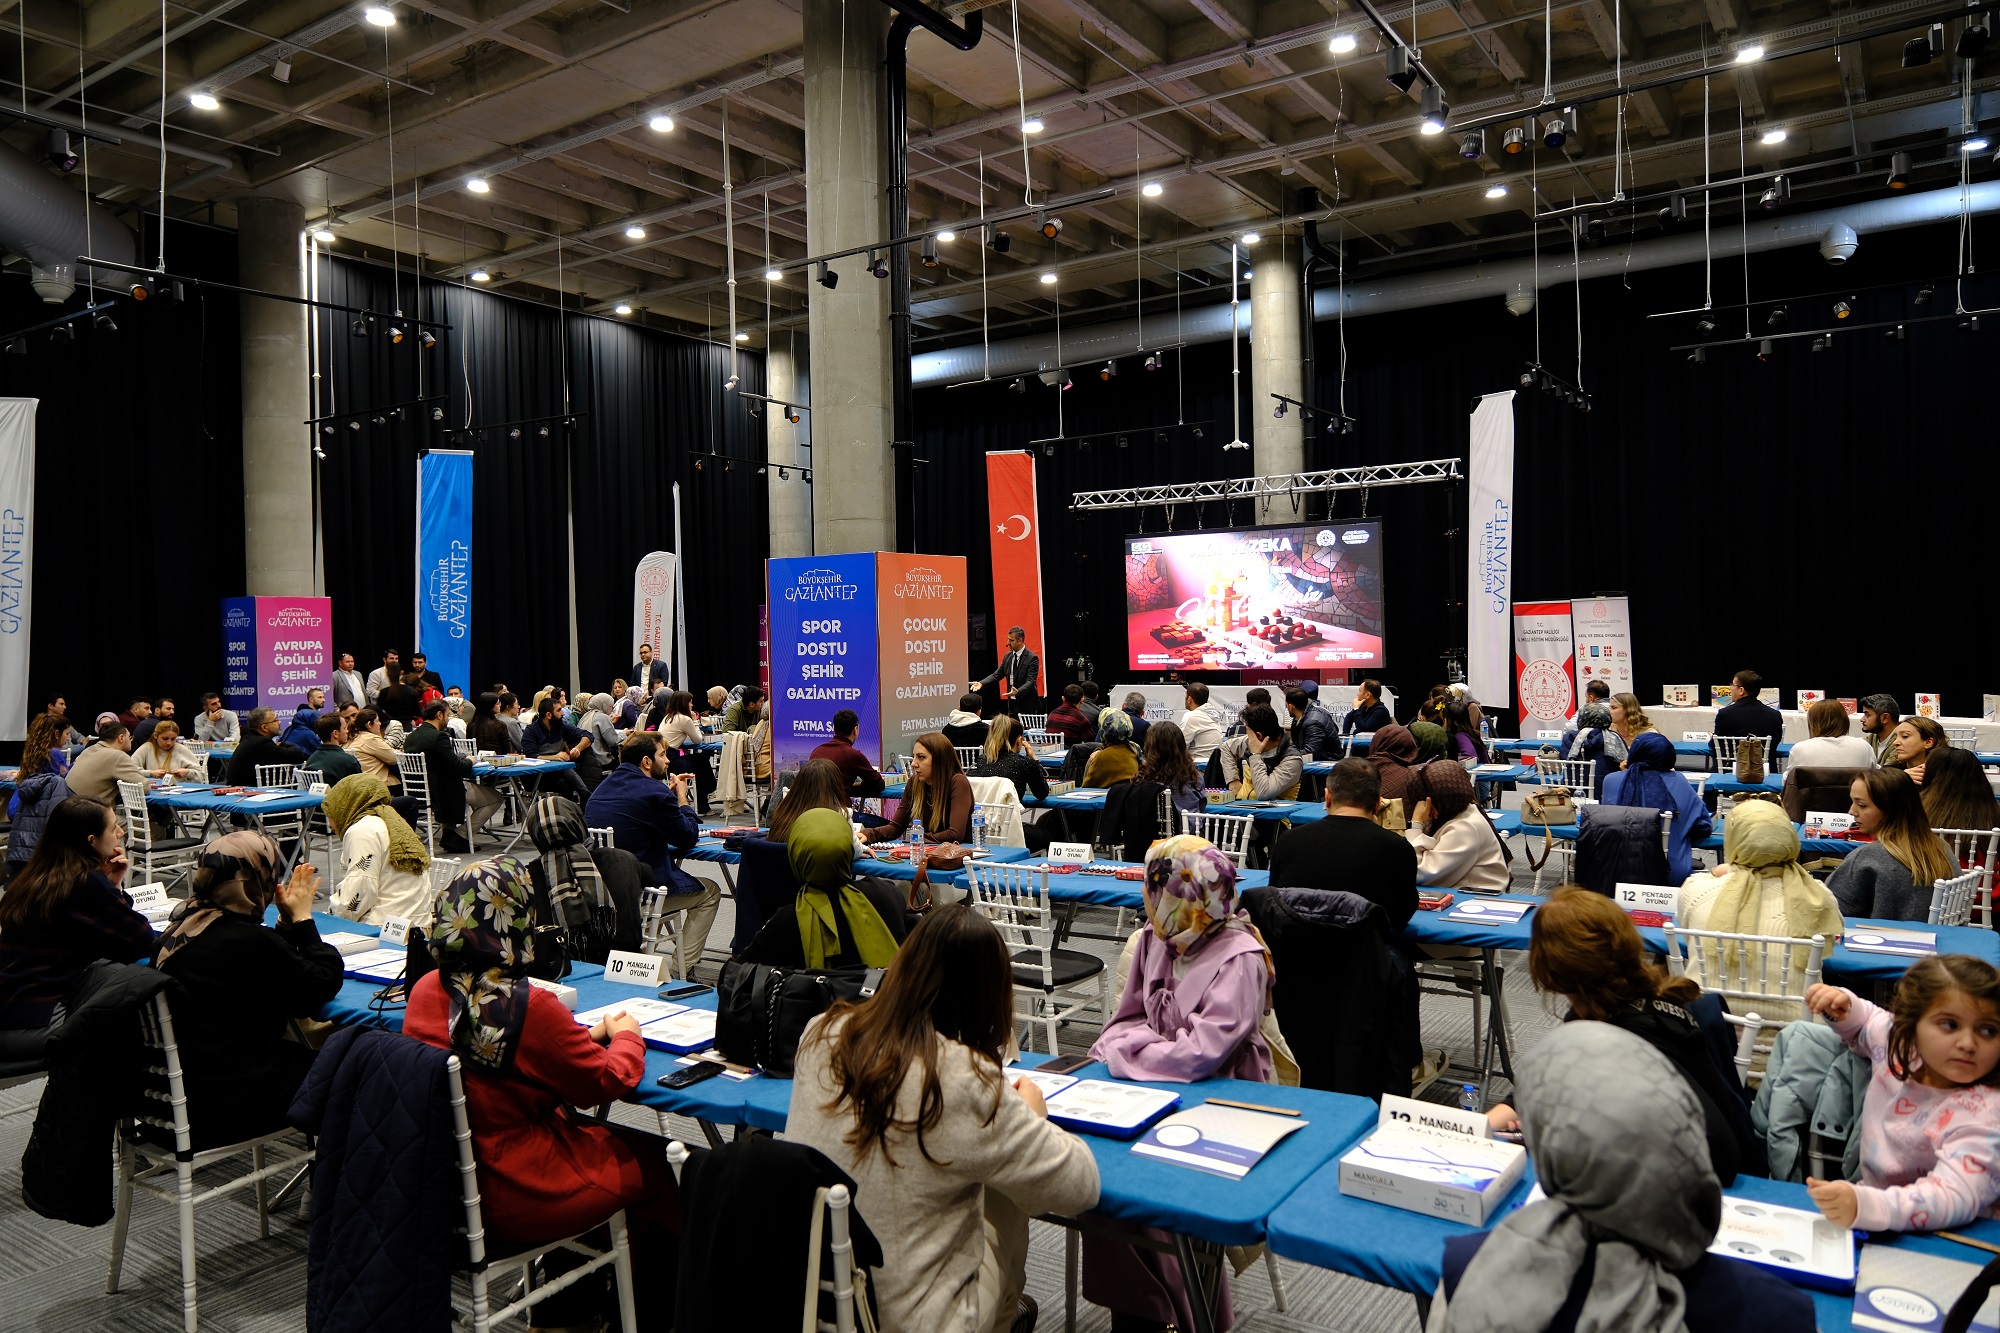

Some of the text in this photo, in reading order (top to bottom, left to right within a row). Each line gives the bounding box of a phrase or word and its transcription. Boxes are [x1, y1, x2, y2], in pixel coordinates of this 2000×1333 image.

[1249, 537, 1293, 553] ZEKA
[1485, 520, 1493, 594] BÜYÜKŞEHİR
[1492, 499, 1508, 614] GAZİANTEP
[0, 509, 24, 634] GAZİANTEP
[905, 573, 943, 584] BÜYÜKŞEHİR
[798, 574, 843, 585] BÜYÜKŞEHİR
[438, 557, 450, 622] BÜYÜKŞEHİR
[448, 540, 468, 639] GAZİANTEP
[784, 584, 858, 602] GAZİANTEP
[894, 583, 954, 600] GAZİANTEP
[268, 617, 322, 627] GAZİANTEP
[801, 619, 842, 635] SPOR
[903, 618, 947, 635] ÇOCUK
[228, 641, 246, 652] SPOR
[273, 641, 323, 651] AVRUPA
[797, 642, 848, 656] DOSTU
[904, 640, 946, 654] DOSTU
[226, 656, 249, 666] DOSTU
[274, 653, 323, 666] ÖDÜLLÜ
[229, 668, 248, 682] ŞEHİR
[281, 667, 317, 682] ŞEHİR
[801, 660, 844, 681] ŞEHİR
[909, 657, 944, 679] ŞEHİR
[223, 685, 255, 696] GAZİANTEP
[786, 684, 861, 700] GAZİANTEP
[895, 682, 957, 699] GAZİANTEP
[793, 720, 825, 731] FATMA
[901, 719, 928, 731] FATMA
[1812, 817, 1824, 825] 13
[1053, 847, 1063, 857] 10
[135, 895, 156, 904] OYUNU
[1622, 890, 1637, 902] 12
[1641, 891, 1674, 899] PENTAGO
[1645, 898, 1669, 906] OYUNU
[384, 921, 390, 933] 9
[611, 959, 624, 973] 10
[626, 961, 655, 971] MANGALA
[629, 969, 650, 978] OYUNU
[1419, 1115, 1475, 1136] MANGALA
[1353, 1171, 1395, 1187] MANGALA
